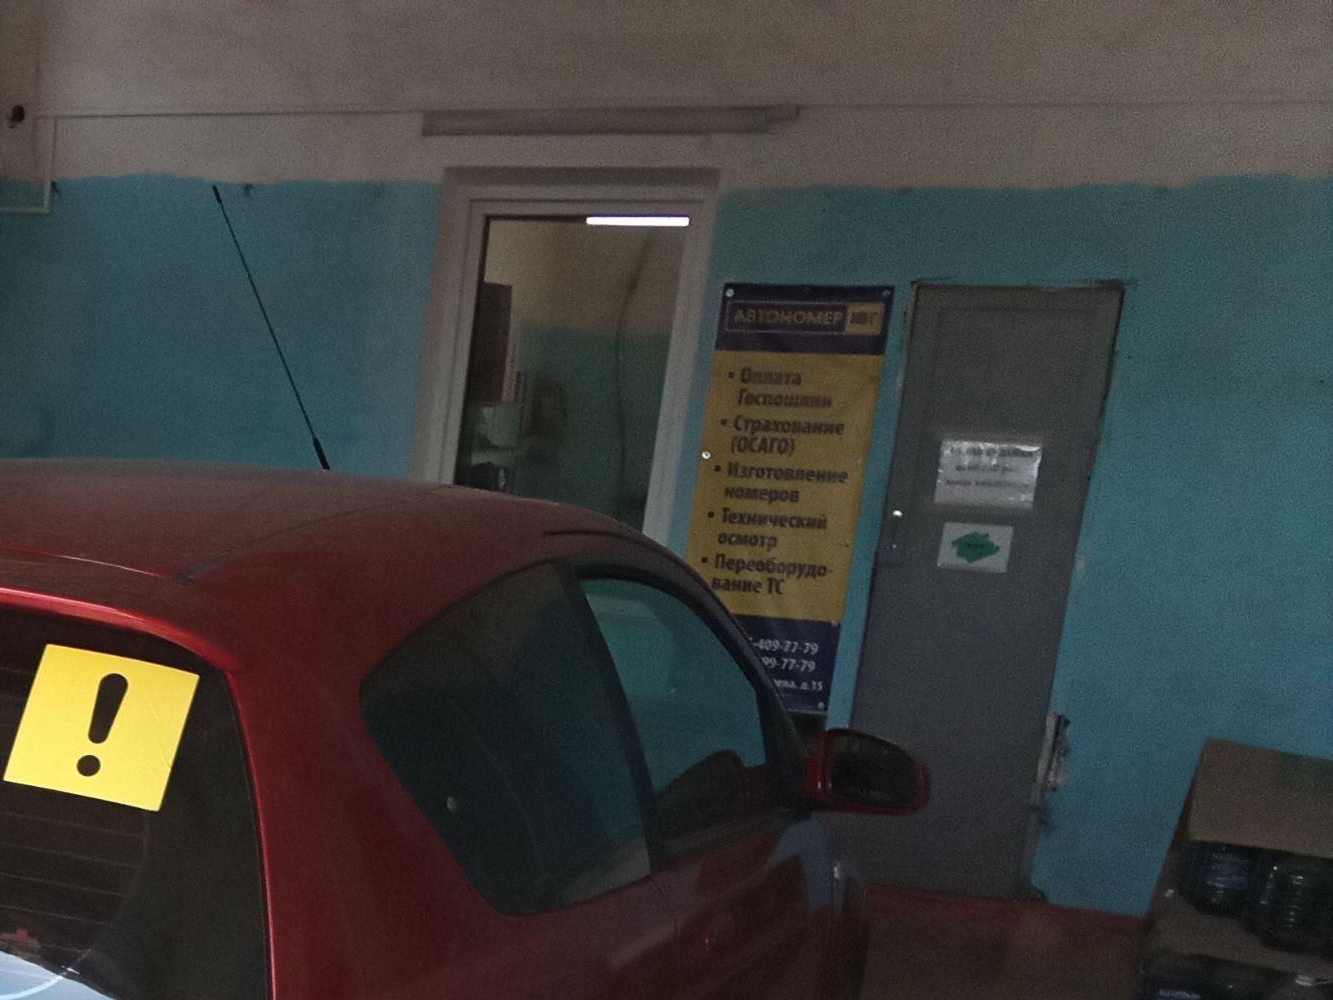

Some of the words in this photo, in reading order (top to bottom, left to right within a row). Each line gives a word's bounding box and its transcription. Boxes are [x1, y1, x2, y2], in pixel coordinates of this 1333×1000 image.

[734, 308, 845, 326] АВТОНОМЕР
[740, 367, 802, 386] Оплата
[733, 414, 845, 436] Страхование
[730, 436, 796, 457] (ОСАГО)
[727, 461, 849, 484] Изготовление
[724, 486, 800, 503] номеров
[721, 507, 828, 530] Технический
[718, 531, 778, 550] осмотр
[711, 577, 763, 594] вание
[766, 577, 785, 595] ТС
